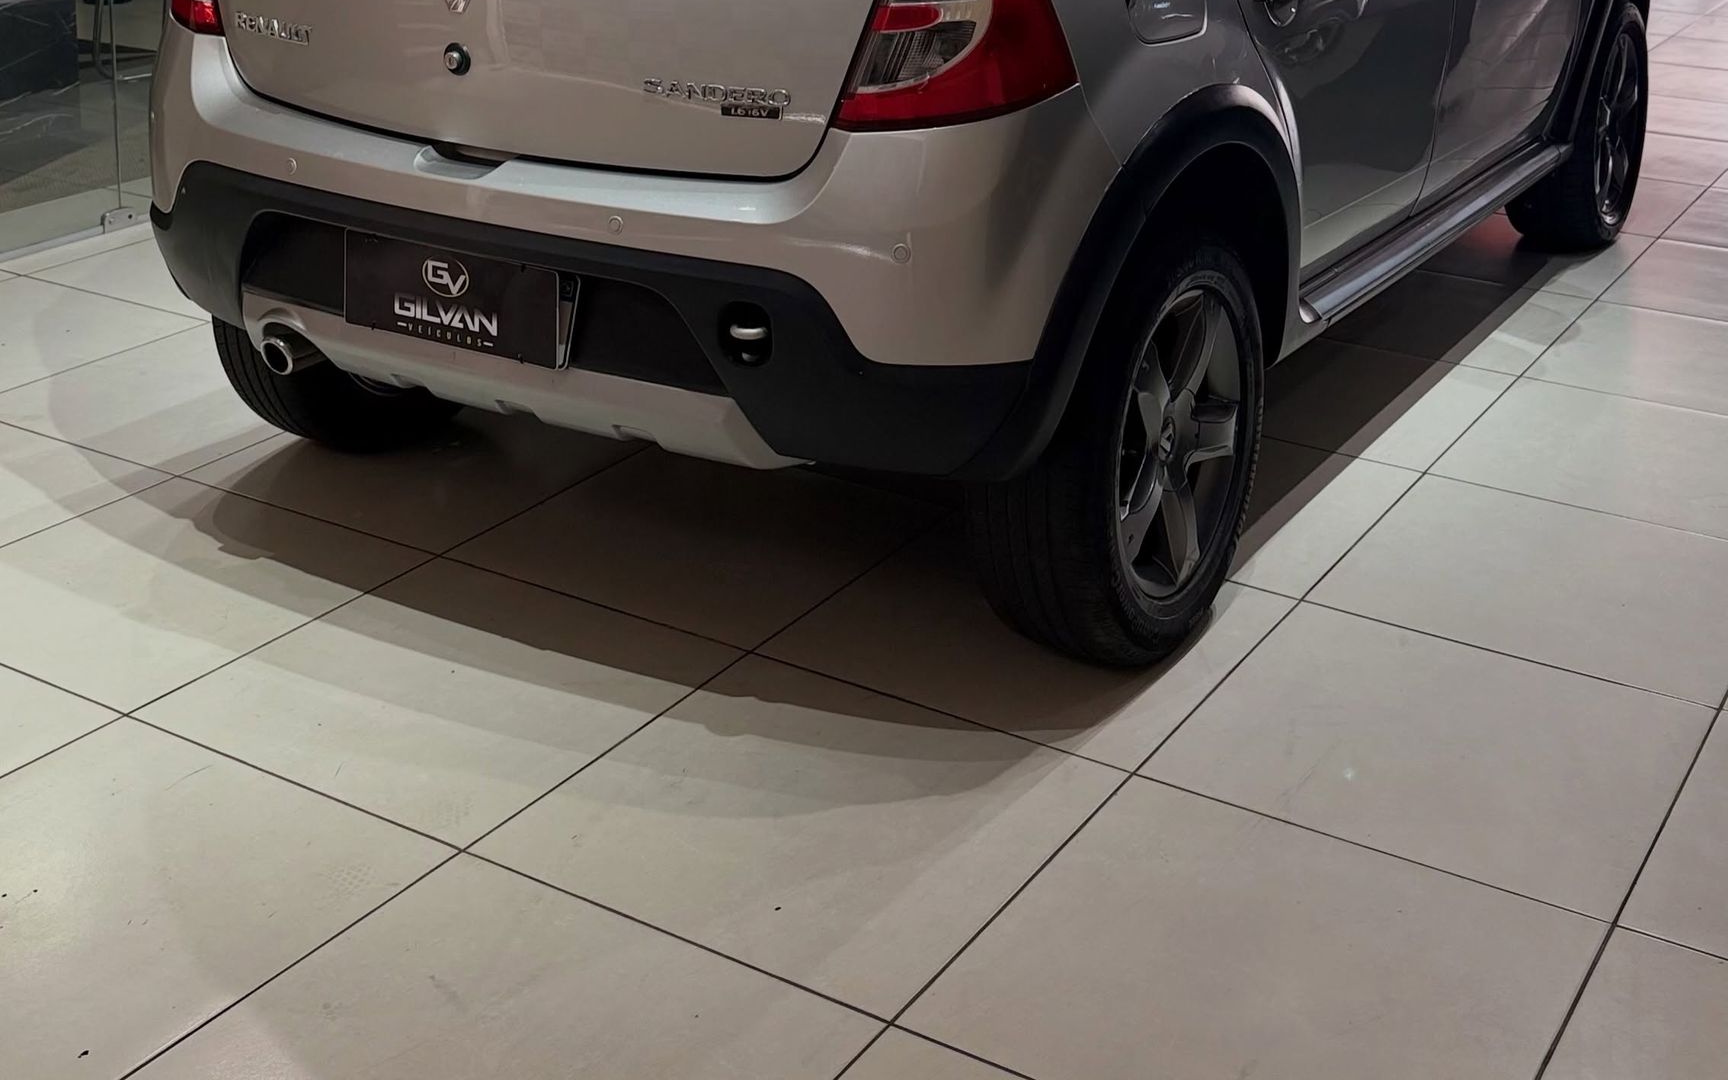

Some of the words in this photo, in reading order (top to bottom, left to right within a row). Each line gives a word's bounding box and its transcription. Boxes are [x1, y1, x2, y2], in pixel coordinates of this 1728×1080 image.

[235, 10, 312, 46] RENAULT
[643, 77, 791, 107] SANDERO
[427, 259, 466, 295] GV
[393, 292, 498, 337] GILVAN
